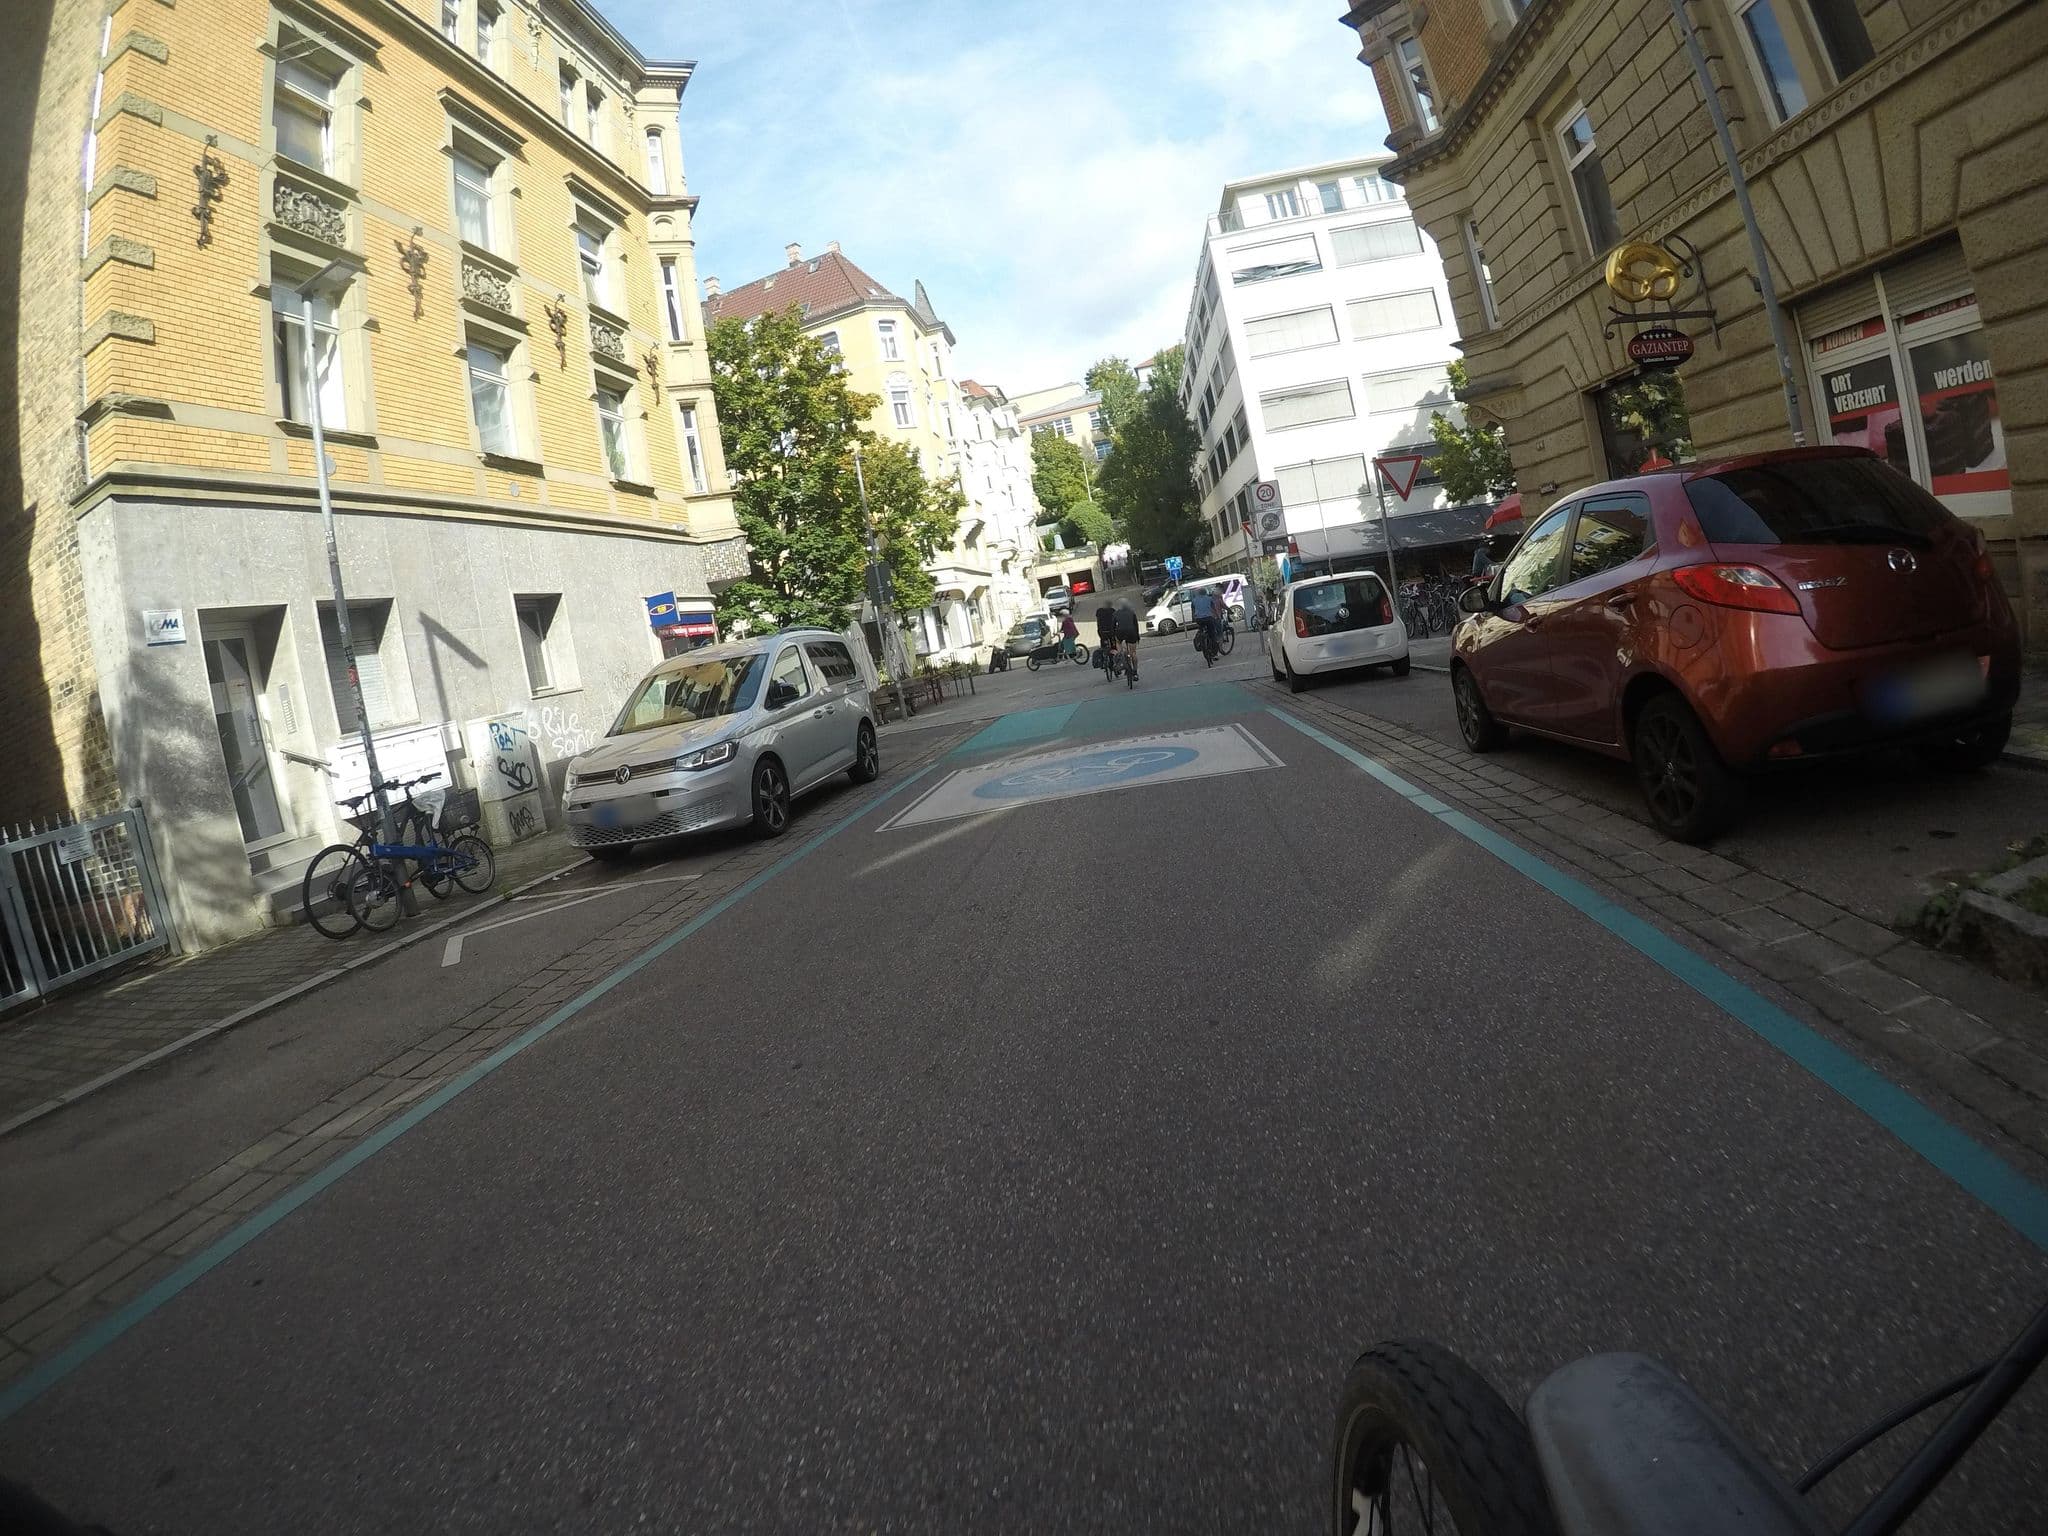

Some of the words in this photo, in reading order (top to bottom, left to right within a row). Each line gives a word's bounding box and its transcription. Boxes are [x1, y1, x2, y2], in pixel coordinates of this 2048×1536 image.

[1632, 340, 1689, 355] GAZIANTEP
[1830, 373, 1852, 394] ORT
[1933, 359, 1992, 390] werden
[1833, 385, 1886, 413] VERZEHRT
[1260, 488, 1271, 498] 20
